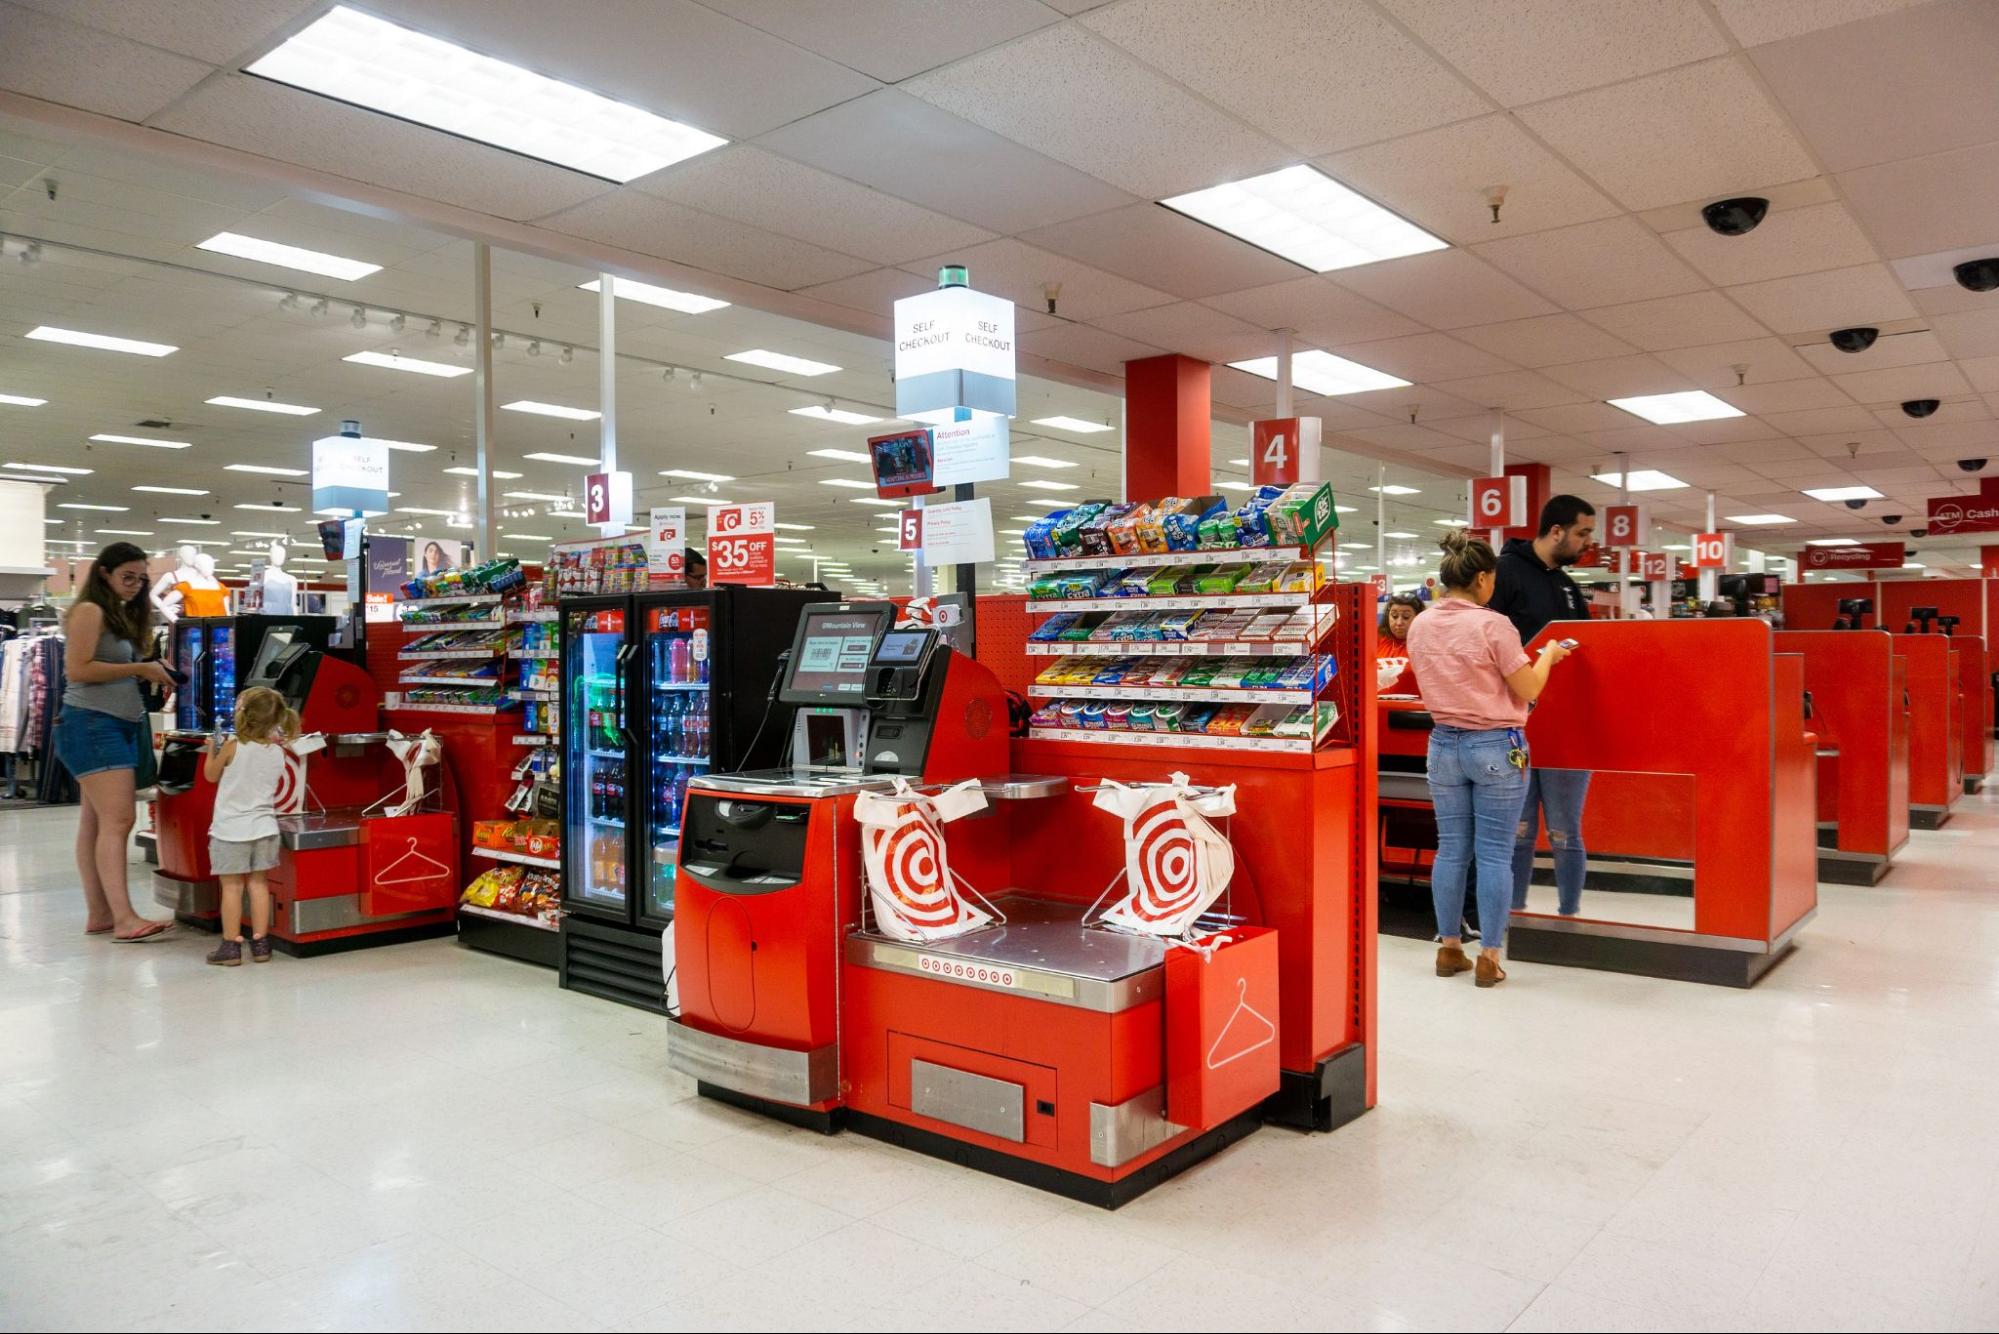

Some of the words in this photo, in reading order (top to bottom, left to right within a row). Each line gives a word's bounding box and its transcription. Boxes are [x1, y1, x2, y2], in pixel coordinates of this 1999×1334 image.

[913, 320, 935, 333] SELF
[978, 320, 998, 333] SELF
[900, 332, 950, 351] CHECKOUT
[965, 333, 1010, 351] CHECKOUT
[937, 429, 970, 440] Attention
[1264, 434, 1288, 469] 4
[591, 484, 604, 513] 3
[1480, 489, 1502, 516] 6
[1966, 508, 1999, 519] Cash
[905, 518, 917, 541] 5
[1612, 515, 1631, 537] 8
[749, 542, 768, 551] OFF
[1698, 540, 1724, 560] 10
[1645, 559, 1666, 575] 12
